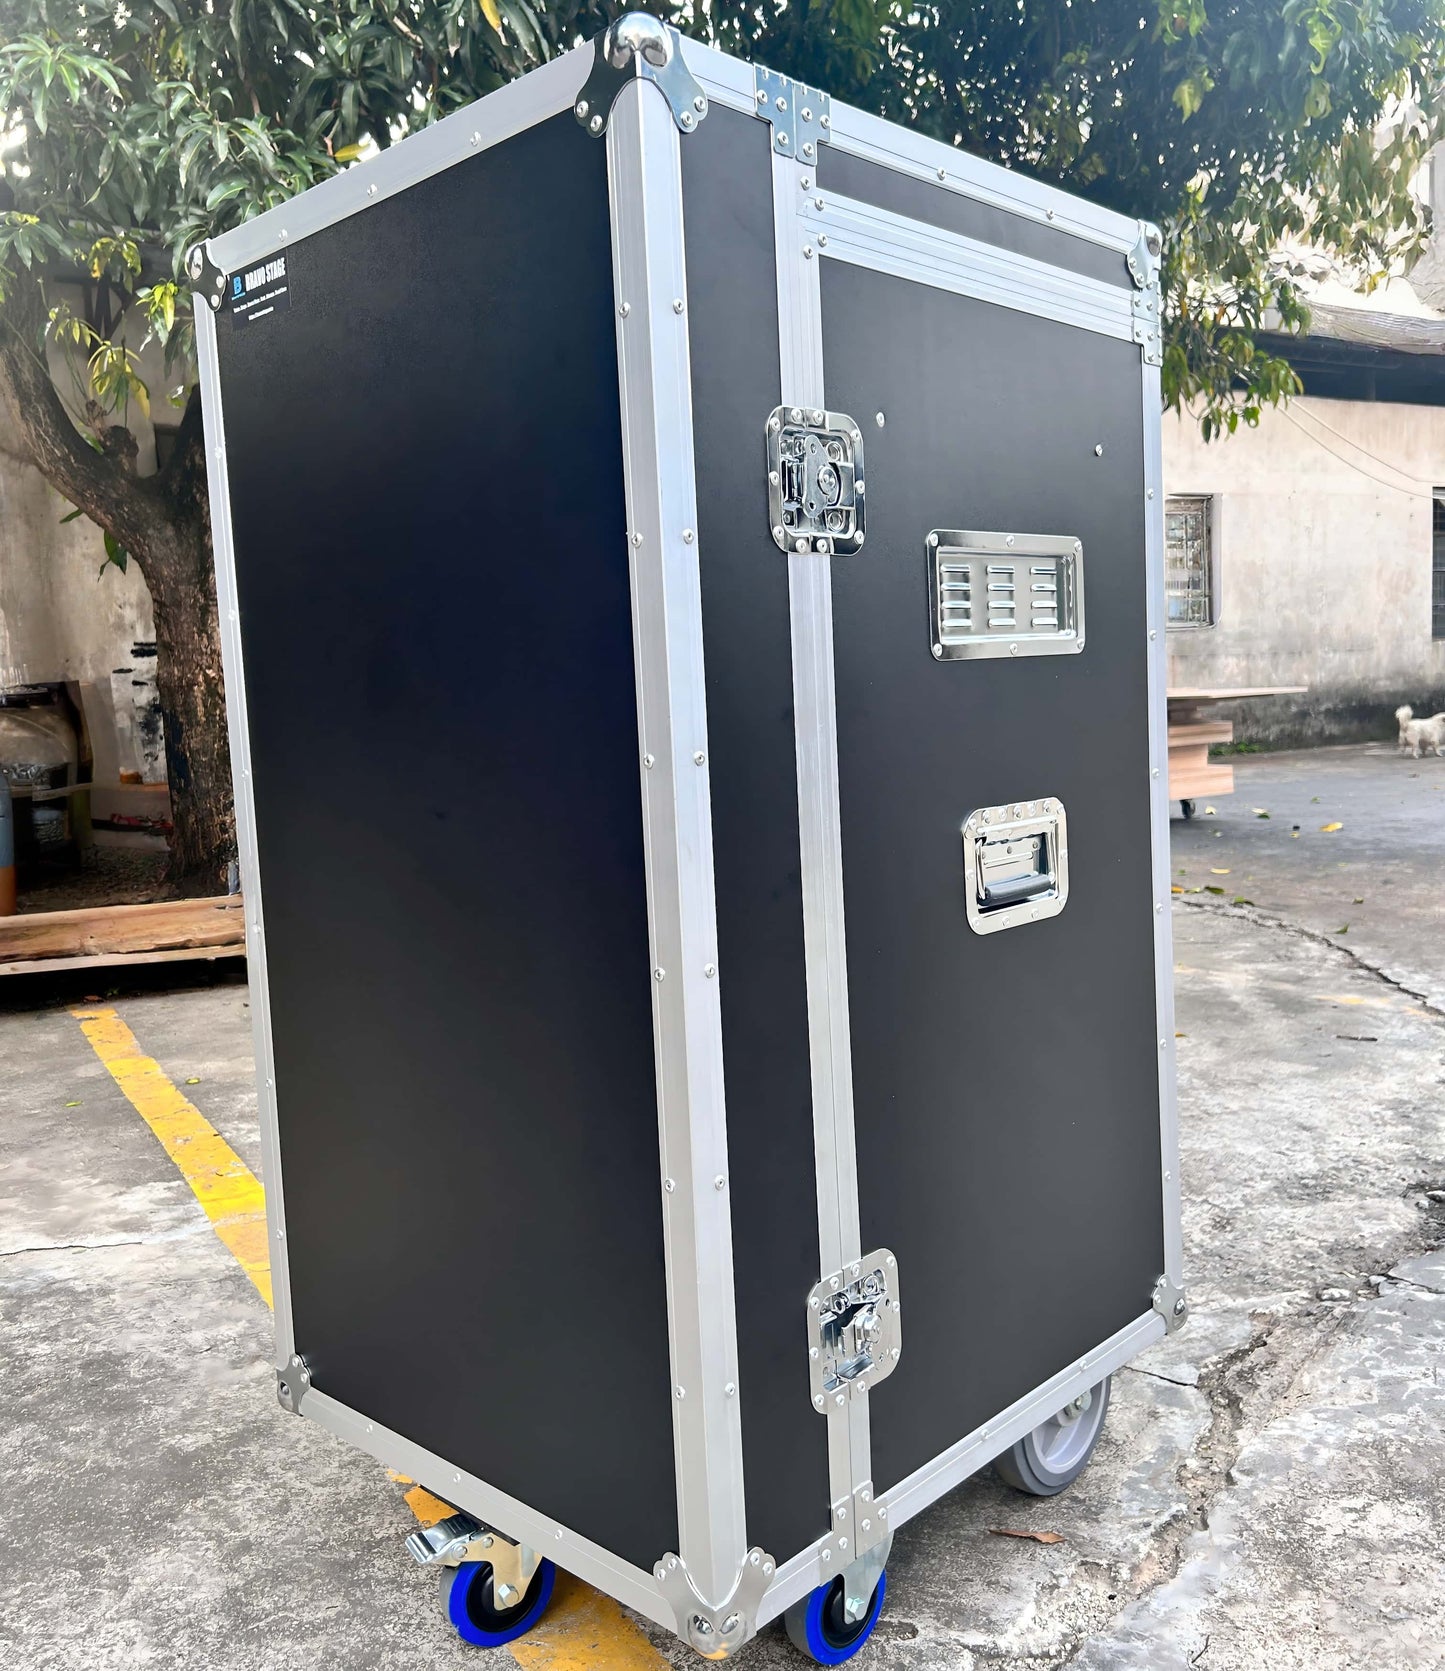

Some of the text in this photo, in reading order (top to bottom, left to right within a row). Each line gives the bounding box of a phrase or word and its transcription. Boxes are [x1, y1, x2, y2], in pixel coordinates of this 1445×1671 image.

[233, 276, 242, 295] B
[245, 257, 286, 292] BRAVO STAGE
